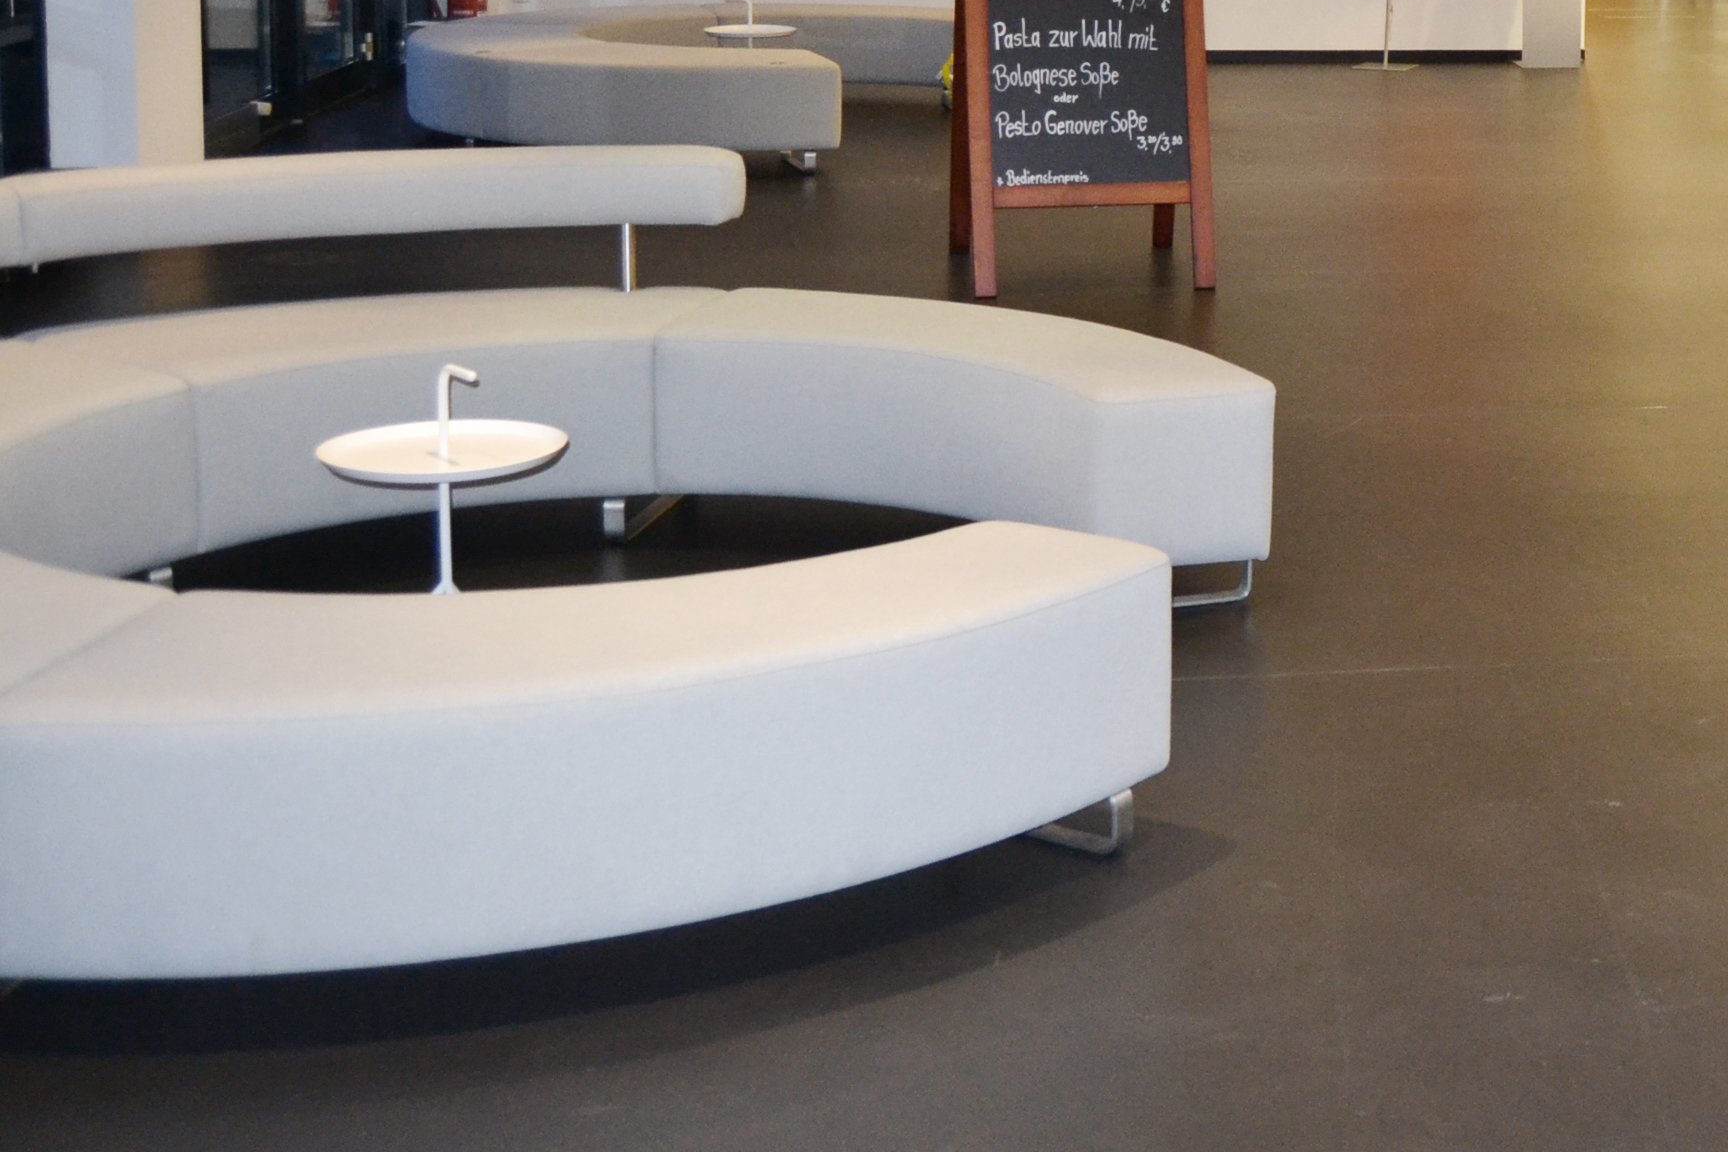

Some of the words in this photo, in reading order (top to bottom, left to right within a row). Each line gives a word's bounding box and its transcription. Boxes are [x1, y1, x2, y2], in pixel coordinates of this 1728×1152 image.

[993, 17, 1040, 51] Pasta
[1049, 28, 1078, 48] zur
[1081, 18, 1122, 49] Wahl
[1128, 23, 1159, 51] mit
[992, 63, 1077, 95] Bolognese
[1053, 92, 1079, 104] oder
[995, 109, 1042, 139] Pesto
[1044, 109, 1108, 136] Genover
